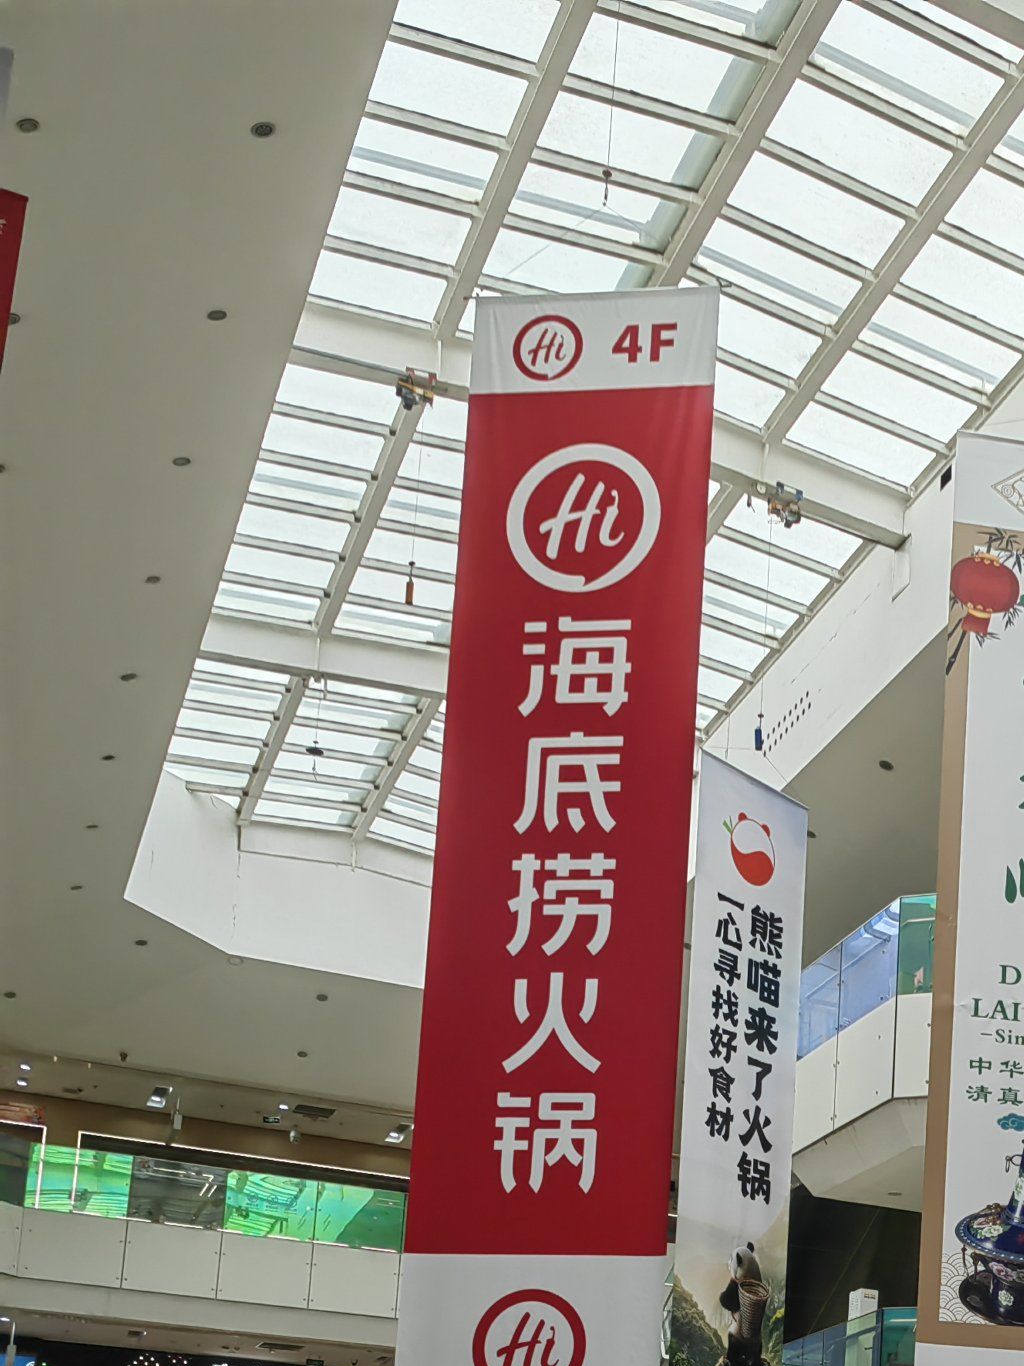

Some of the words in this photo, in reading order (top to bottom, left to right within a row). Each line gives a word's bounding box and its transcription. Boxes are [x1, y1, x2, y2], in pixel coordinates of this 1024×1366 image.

[611, 323, 678, 364] 4F
[539, 472, 624, 560] Hi
[493, 616, 633, 1196] 海底捞火锅
[705, 891, 744, 1143] 一心寻找好食材
[737, 904, 784, 1206] 熊喵来了火锅
[970, 997, 1023, 1023] LAI
